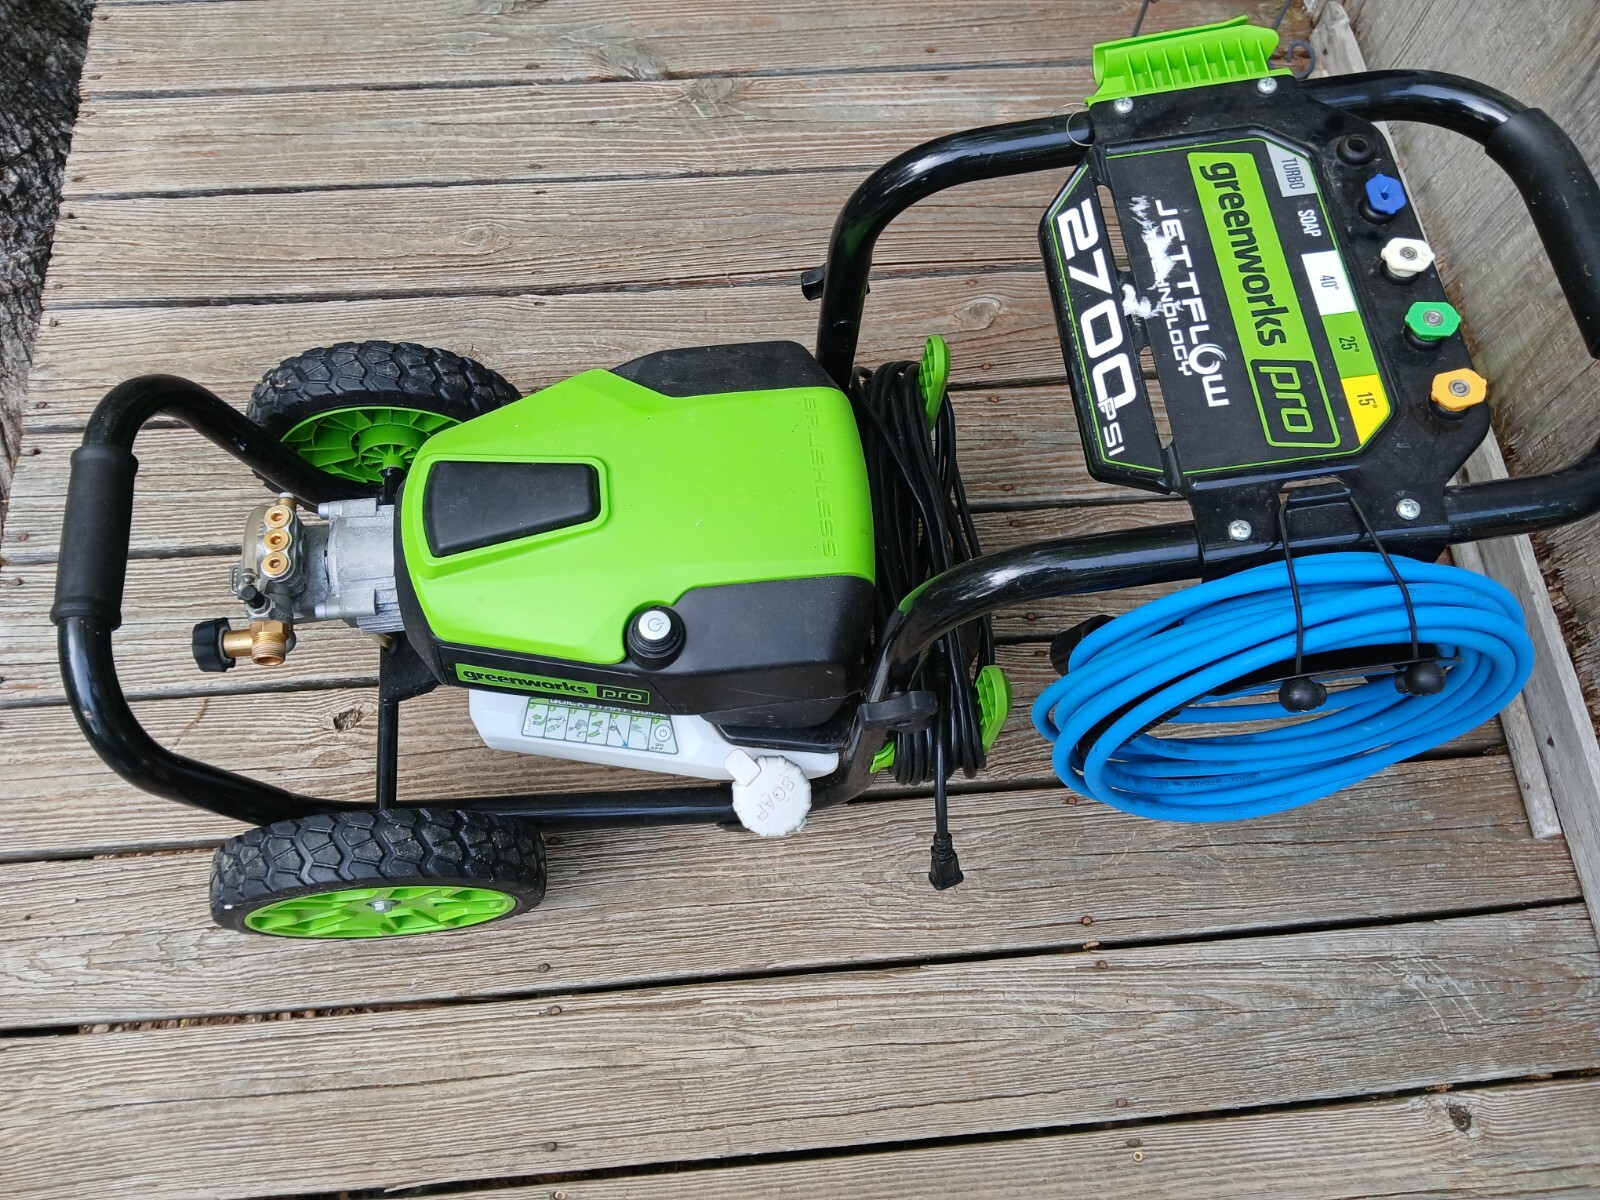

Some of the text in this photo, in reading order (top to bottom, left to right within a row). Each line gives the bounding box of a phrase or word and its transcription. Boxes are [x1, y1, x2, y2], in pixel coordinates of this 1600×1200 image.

[1281, 157, 1305, 190] TURBO
[1297, 208, 1321, 238] SOAP
[1200, 161, 1314, 434] greenworks pro
[1057, 199, 1137, 457] 2700 PSI
[804, 397, 837, 557] BRUSHLESS
[463, 670, 642, 701] greenworks pro
[757, 776, 795, 821] SOAP
